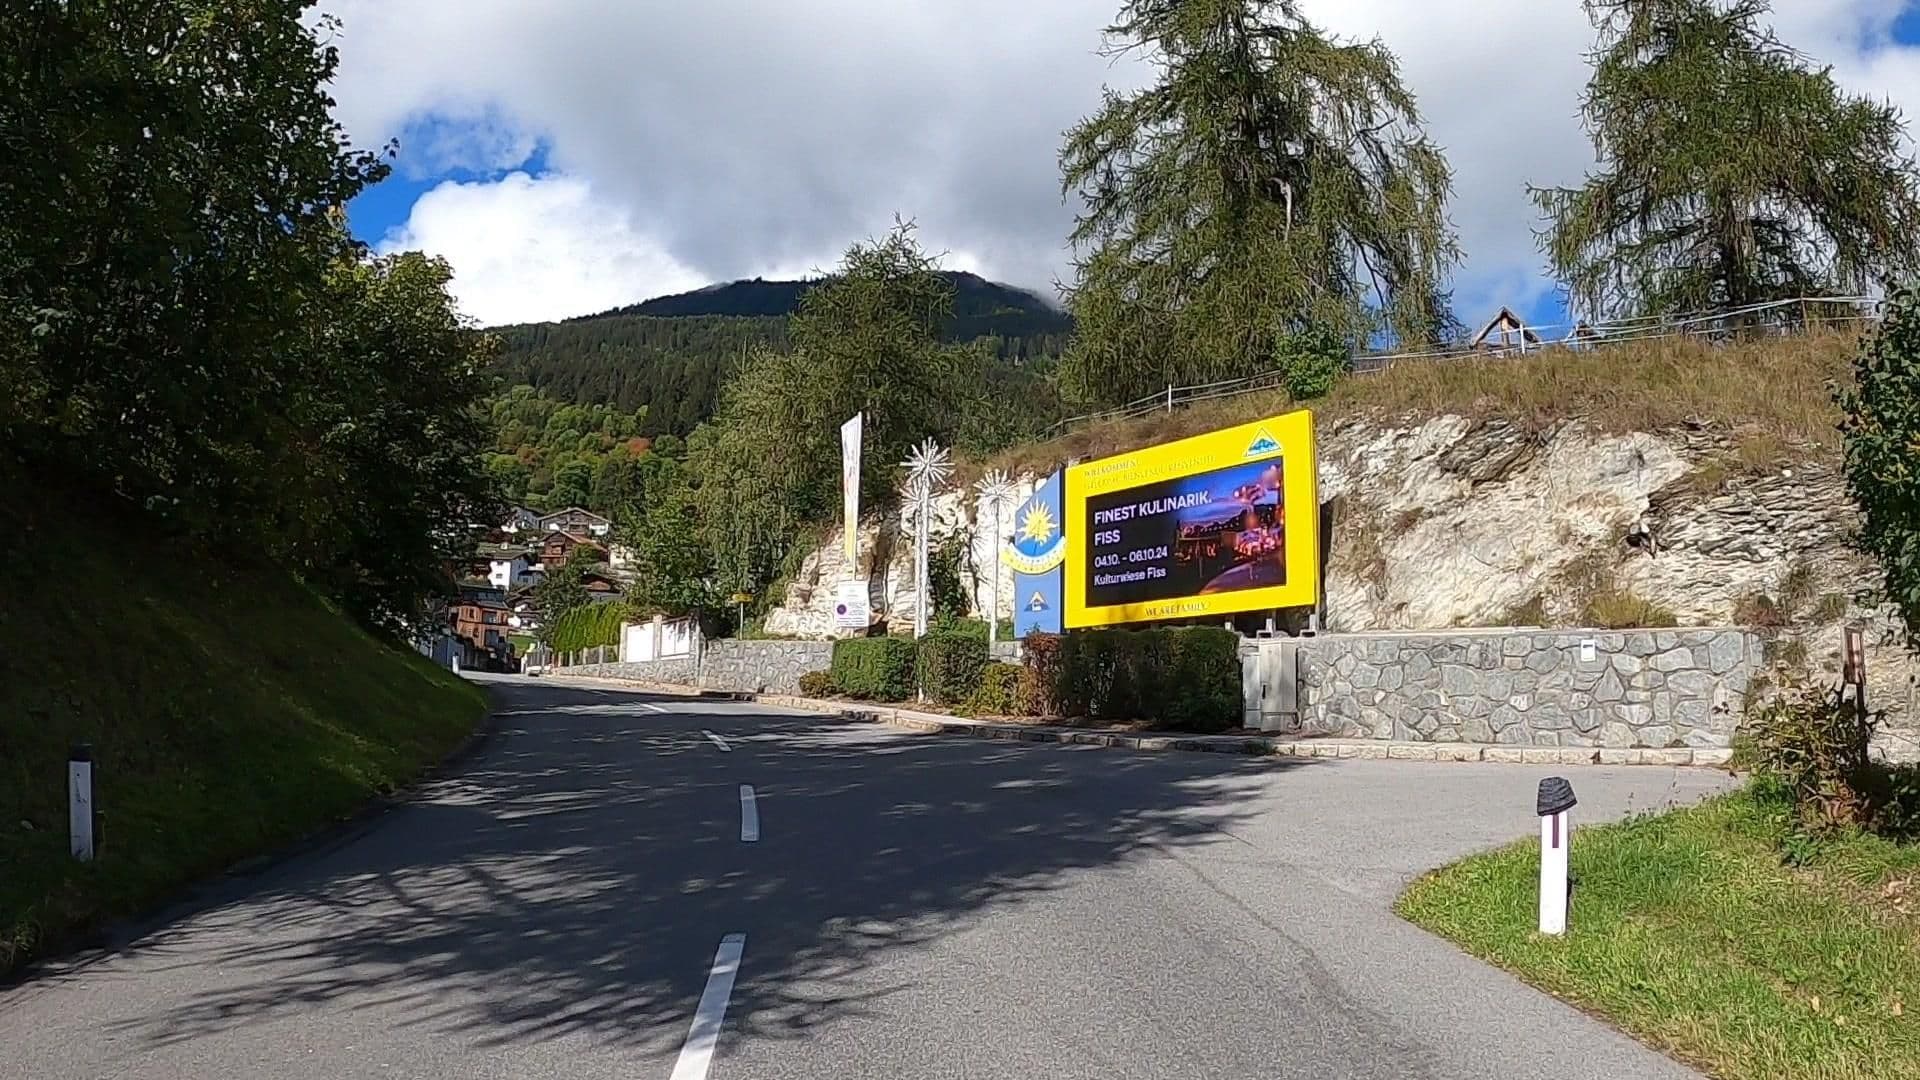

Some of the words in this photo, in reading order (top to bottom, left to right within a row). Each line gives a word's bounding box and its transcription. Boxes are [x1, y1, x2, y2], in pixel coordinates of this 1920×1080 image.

[1094, 504, 1137, 525] FINEST
[1138, 490, 1213, 517] KULINARIK.
[1094, 529, 1121, 546] FISS
[1094, 553, 1121, 568] 04.10.
[1094, 569, 1146, 586] Kulturwiese
[1147, 566, 1167, 579] Fiss
